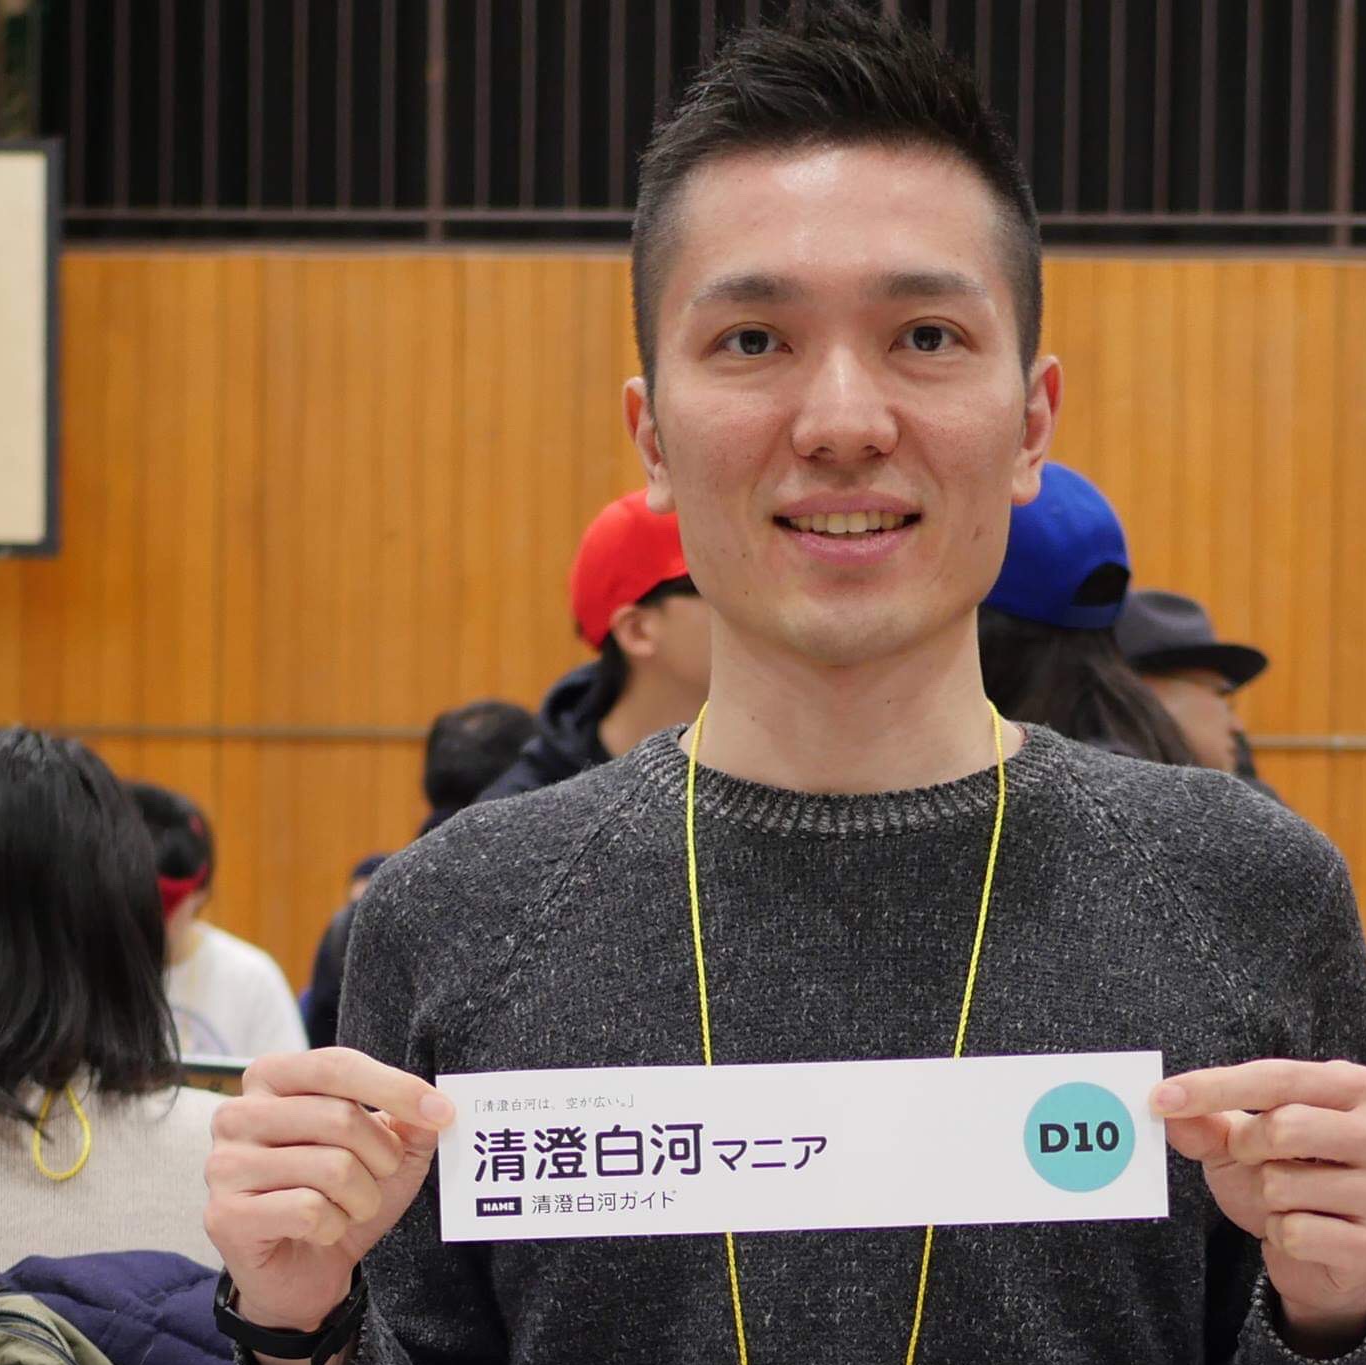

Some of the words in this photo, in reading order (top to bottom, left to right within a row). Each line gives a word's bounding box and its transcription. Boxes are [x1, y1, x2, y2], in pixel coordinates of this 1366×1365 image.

[474, 1095, 635, 1113] 「清澄白河は、空が広い。」
[1040, 1121, 1120, 1154] D10
[473, 1123, 828, 1183] 清澄白河マニア
[532, 1190, 678, 1214] 清澄白河ガイド
